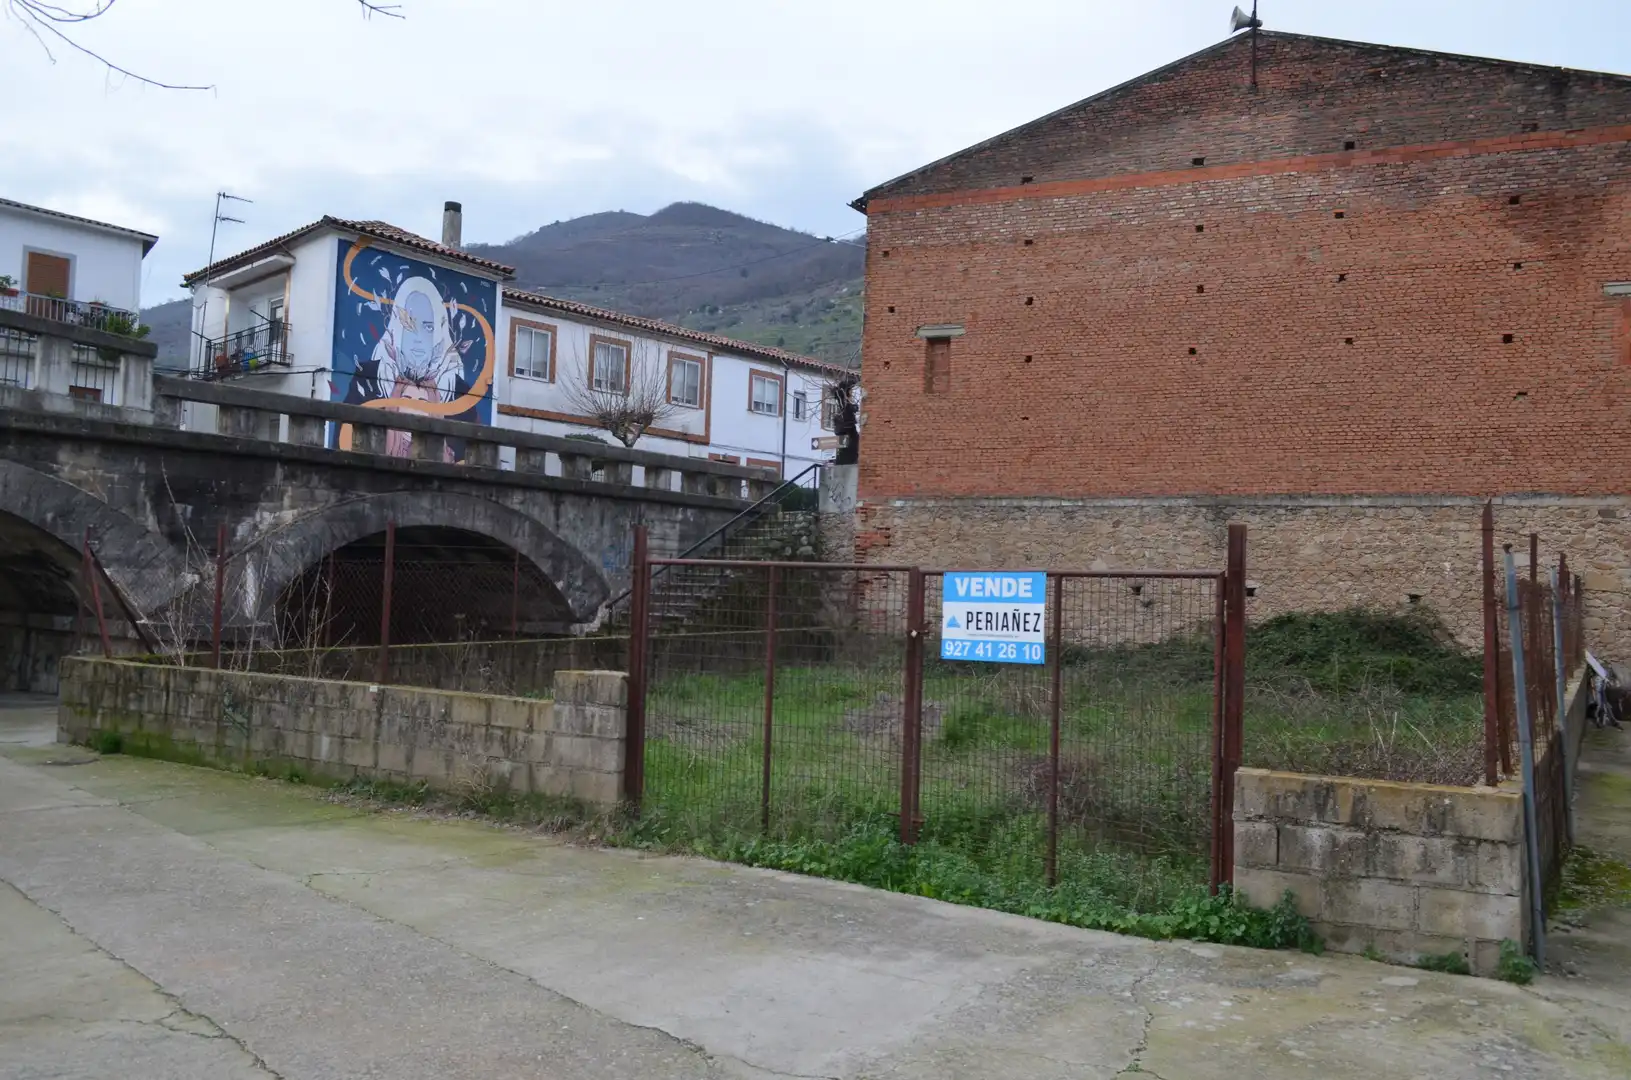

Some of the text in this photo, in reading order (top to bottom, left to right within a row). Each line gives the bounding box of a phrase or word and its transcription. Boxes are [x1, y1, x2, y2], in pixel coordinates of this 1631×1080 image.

[955, 578, 1032, 598] VENDE
[966, 609, 1041, 633] PERIAÑEZ
[945, 641, 1041, 660] 927 41 26 10
